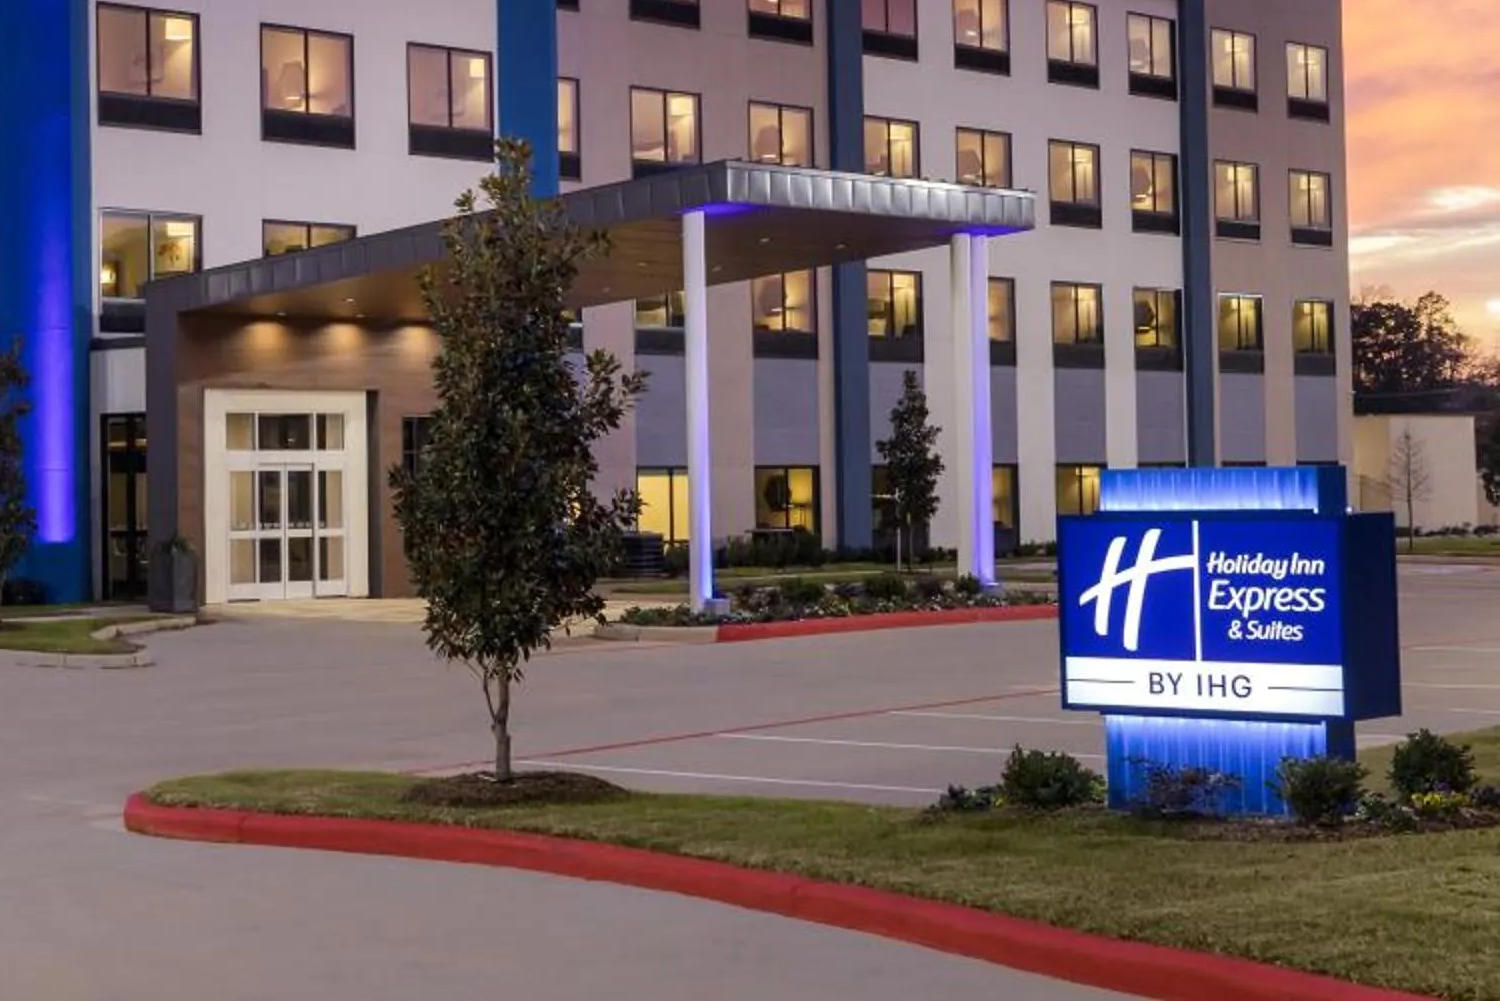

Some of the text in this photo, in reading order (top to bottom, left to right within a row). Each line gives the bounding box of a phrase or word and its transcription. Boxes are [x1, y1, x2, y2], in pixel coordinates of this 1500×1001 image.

[1206, 551, 1325, 579] Holiday Inn
[1208, 579, 1326, 618] Express
[1228, 620, 1304, 641] & Suites
[1149, 672, 1253, 698] BY IHG
